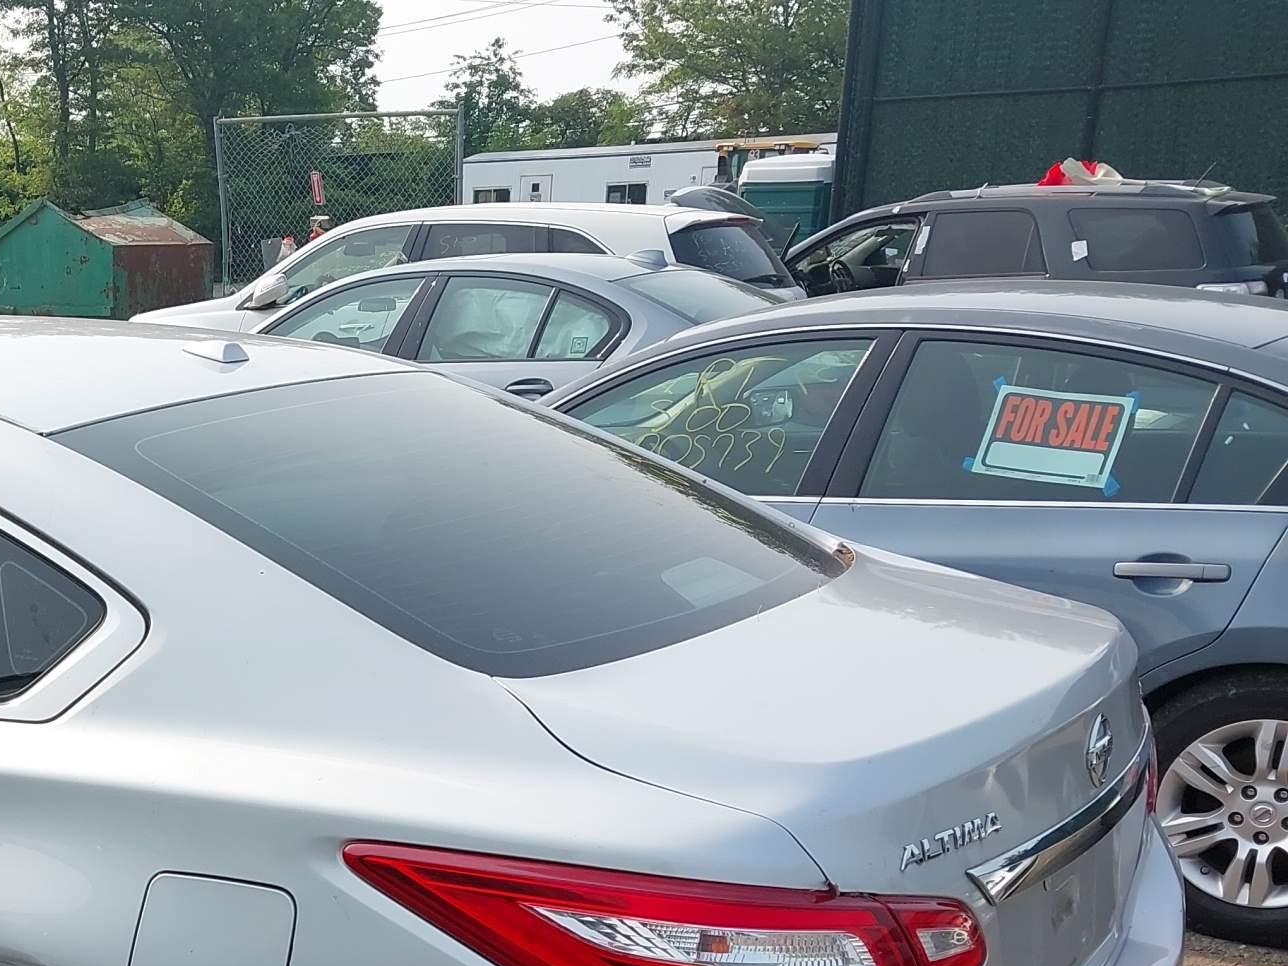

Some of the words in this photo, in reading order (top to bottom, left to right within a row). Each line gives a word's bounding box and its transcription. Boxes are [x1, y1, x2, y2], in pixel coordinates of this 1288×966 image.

[995, 394, 1053, 444] FOR
[1047, 400, 1121, 452] SALE
[899, 811, 1003, 873] ALTIMA
